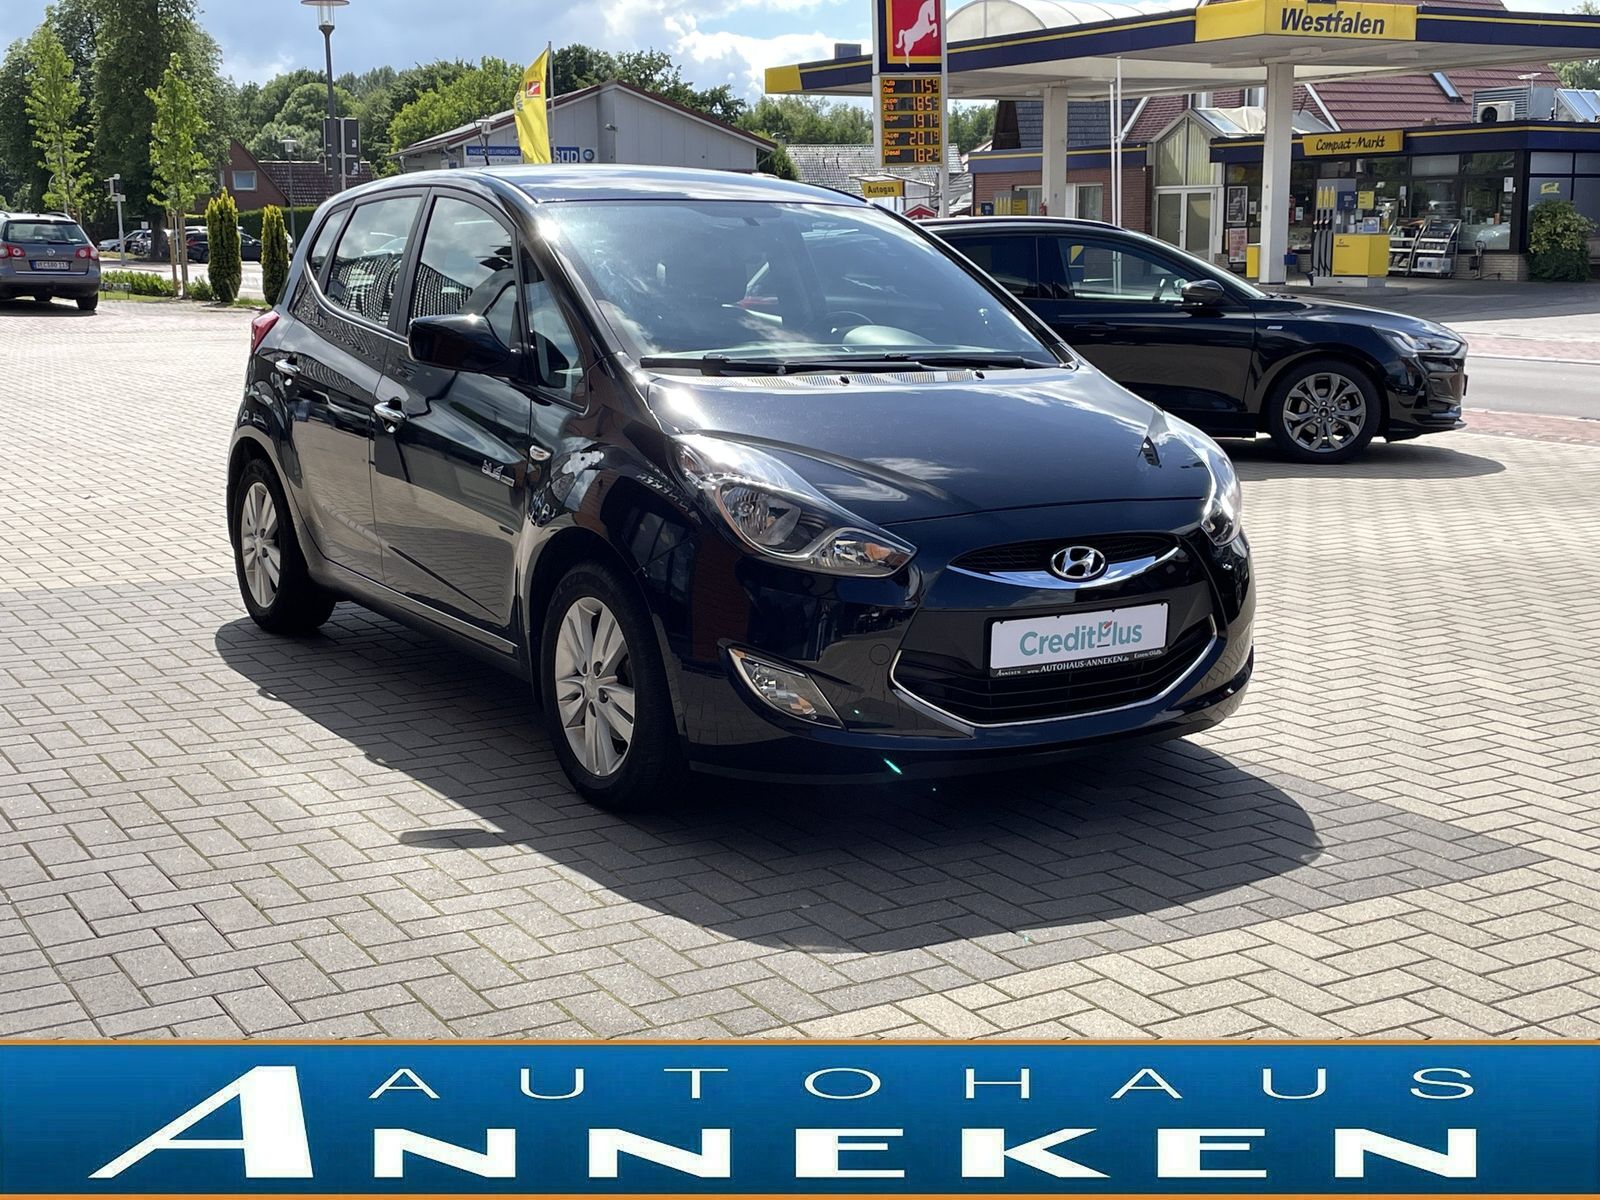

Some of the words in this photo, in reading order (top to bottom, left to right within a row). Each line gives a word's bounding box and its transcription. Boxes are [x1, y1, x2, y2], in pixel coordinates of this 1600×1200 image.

[1281, 8, 1385, 35] Westfalen
[1316, 136, 1386, 153] Compact-Markt
[867, 185, 895, 194] Autogas
[1019, 620, 1143, 656] CreditPlus
